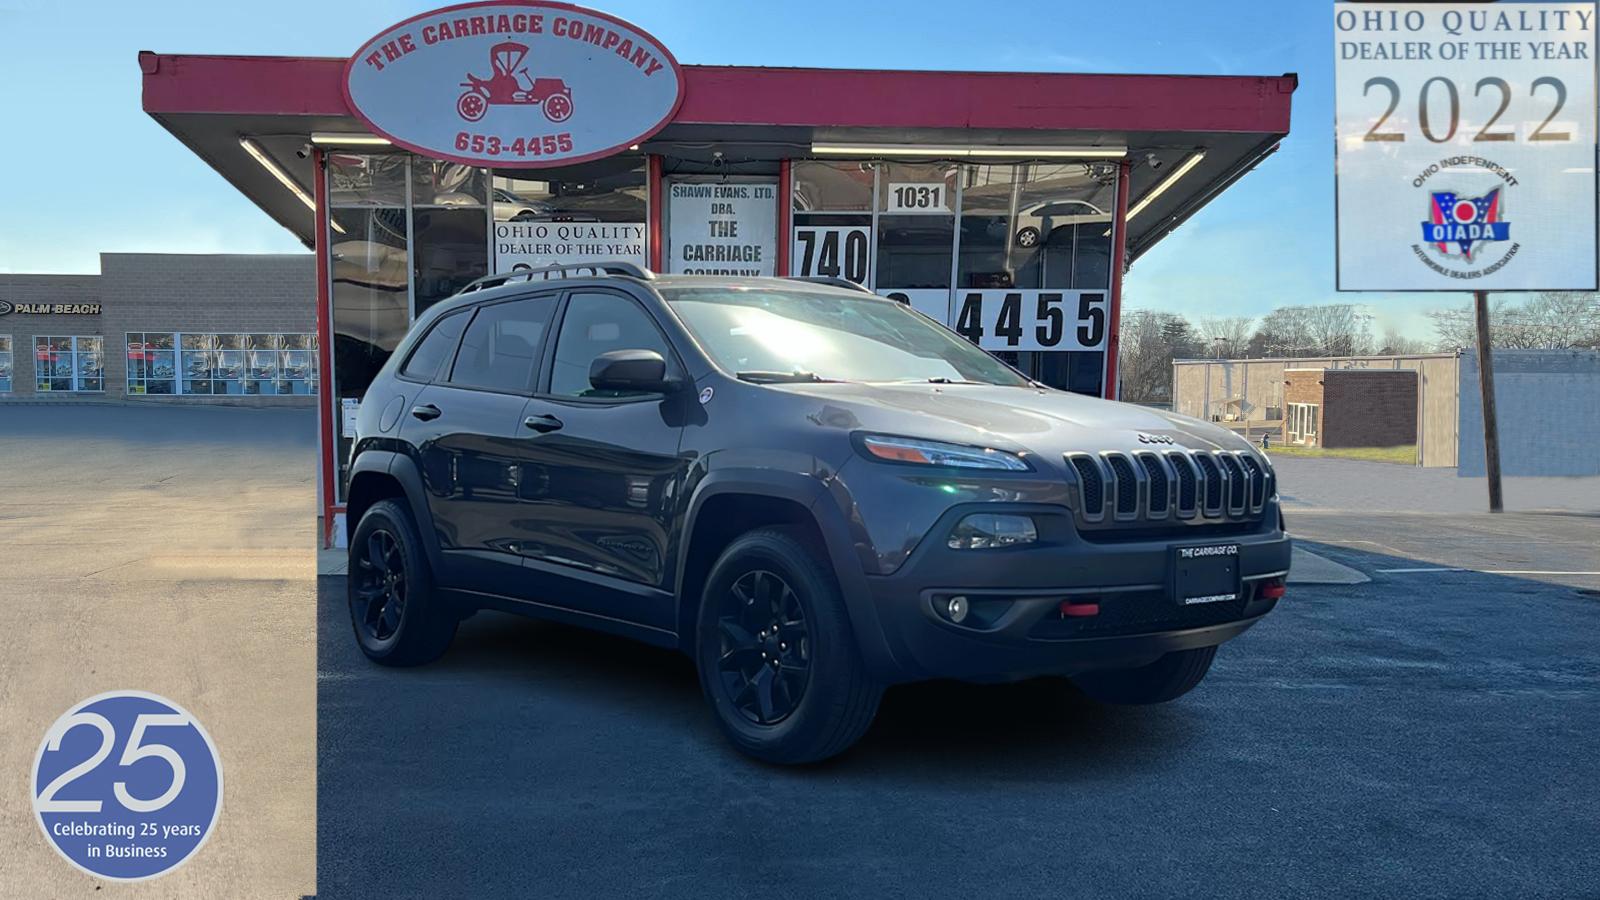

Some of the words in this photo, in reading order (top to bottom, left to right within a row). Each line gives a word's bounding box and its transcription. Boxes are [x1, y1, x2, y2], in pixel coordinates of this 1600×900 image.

[1336, 10, 1425, 31] OHIO
[1442, 10, 1593, 35] QUALITY
[366, 33, 416, 72] THE
[422, 14, 544, 45] CARRIAGE
[552, 16, 664, 77] COMPANY
[1340, 42, 1433, 60] DEALER
[1438, 42, 1470, 60] OF
[1475, 42, 1522, 60] THE
[1528, 42, 1589, 60] YEAR
[1363, 76, 1571, 143] 2022
[455, 132, 573, 157] 653-4455
[1412, 164, 1439, 188] OHIO
[1440, 156, 1519, 187] INDEPENDENT
[672, 186, 712, 198] SHAWN
[754, 187, 775, 199] LTD.
[895, 186, 941, 208] 1031
[711, 203, 736, 215] DBA.
[497, 226, 548, 239] OHIO
[558, 226, 644, 241] QUALITY
[708, 220, 738, 238] THE
[1432, 224, 1495, 240] OIADA
[499, 243, 552, 255] DEALER
[555, 243, 574, 255] OF
[576, 243, 603, 255] THE
[605, 243, 642, 255] YEAR
[683, 244, 762, 262] CARRIAGE
[797, 230, 868, 284] 740
[1411, 244, 1450, 277] AUTOMOBILE
[1449, 269, 1482, 279] DEALERS
[1482, 242, 1521, 276] ASSOCIATION
[15, 304, 51, 314] PALM
[54, 304, 100, 314] BEACH
[956, 293, 1105, 347] 4455
[1181, 547, 1194, 558] THE
[1194, 546, 1227, 557] CARRIAGE
